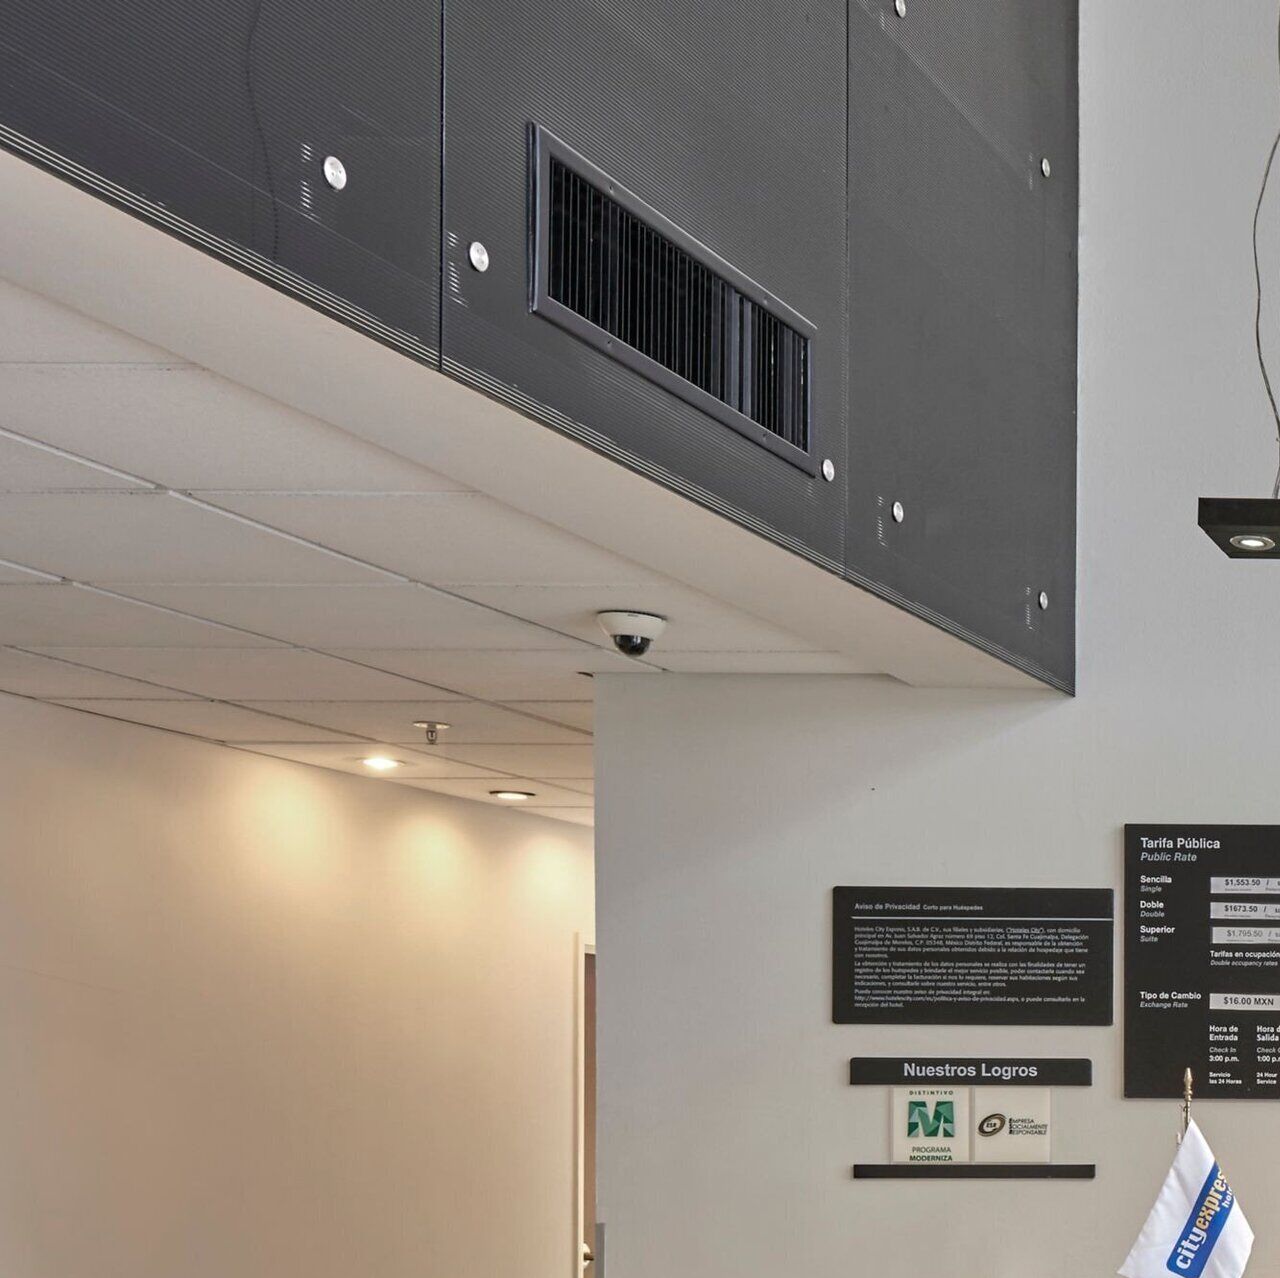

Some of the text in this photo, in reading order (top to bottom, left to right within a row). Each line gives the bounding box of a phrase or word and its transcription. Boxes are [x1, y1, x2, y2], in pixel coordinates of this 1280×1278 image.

[1140, 837, 1221, 849] Tarifa Pública
[1140, 852, 1198, 861] Public Rate
[1140, 875, 1172, 883] Sencilla
[1140, 885, 1162, 893] Single
[884, 903, 920, 911] Privacidad
[1140, 900, 1164, 909] Doble
[1140, 925, 1176, 934] Superior
[1210, 950, 1233, 958] Tarifas
[1245, 950, 1280, 959] ocupación
[1140, 991, 1201, 1000] Tipo de Cambio
[1140, 1001, 1171, 1009] Exchange
[1223, 996, 1274, 1006] $16.00 MXN
[1209, 1025, 1239, 1033] Hora de
[1256, 1025, 1275, 1033] Hora
[1209, 1033, 1239, 1041] Entrada
[903, 1062, 1038, 1080] Nuestros Logros
[907, 1101, 955, 1137] M
